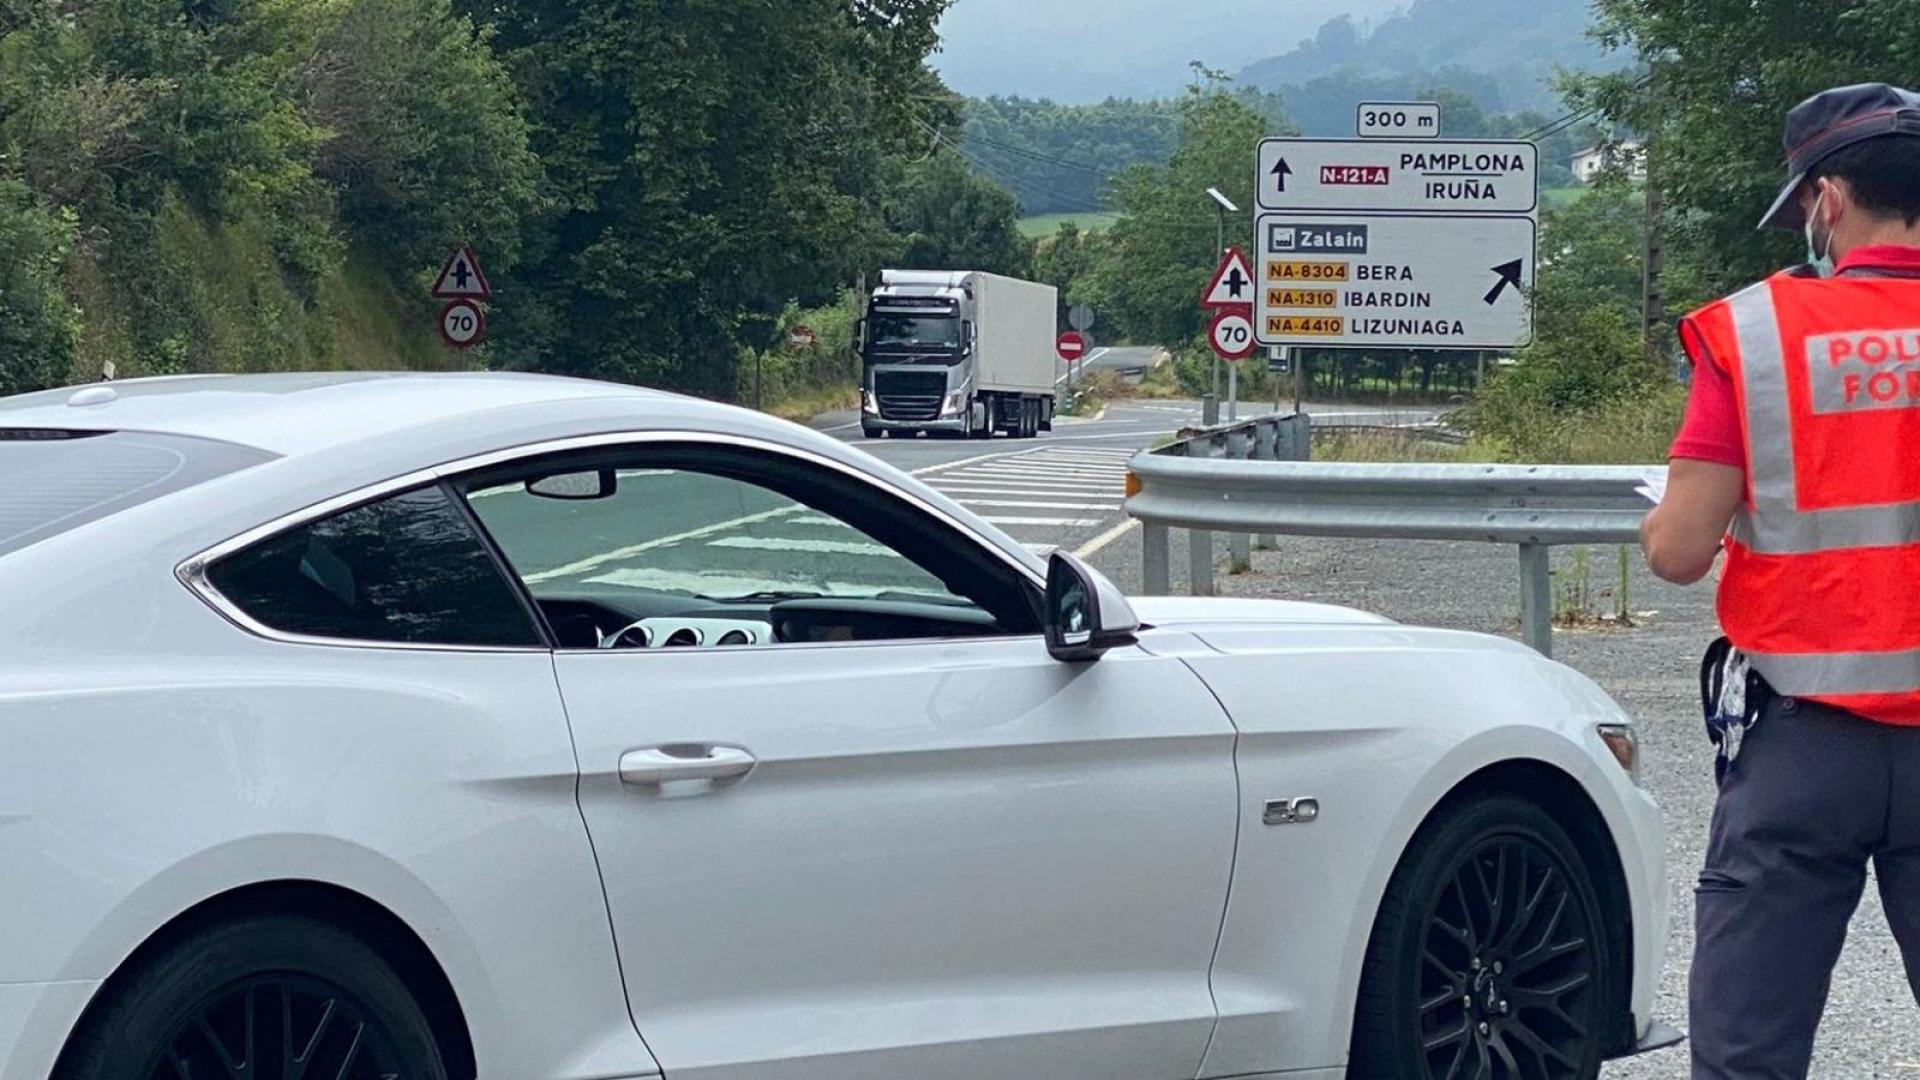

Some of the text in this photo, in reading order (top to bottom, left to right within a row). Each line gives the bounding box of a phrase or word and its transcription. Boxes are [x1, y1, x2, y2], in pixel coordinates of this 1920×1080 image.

[1365, 111, 1433, 127] 300 m
[1400, 153, 1524, 171] PAMPLONA
[1322, 168, 1387, 183] N-121-A
[1426, 179, 1496, 199] IRUÑA
[1301, 231, 1363, 247] Zalain
[1270, 264, 1413, 281] NA-8304 BERA
[1269, 291, 1431, 308] NA-1310 IBARDIN
[449, 316, 473, 332] 70
[1269, 318, 1465, 336] NA-4410 LIZUNIAGA
[1222, 326, 1247, 343] 70
[1262, 797, 1320, 826] 5.0
